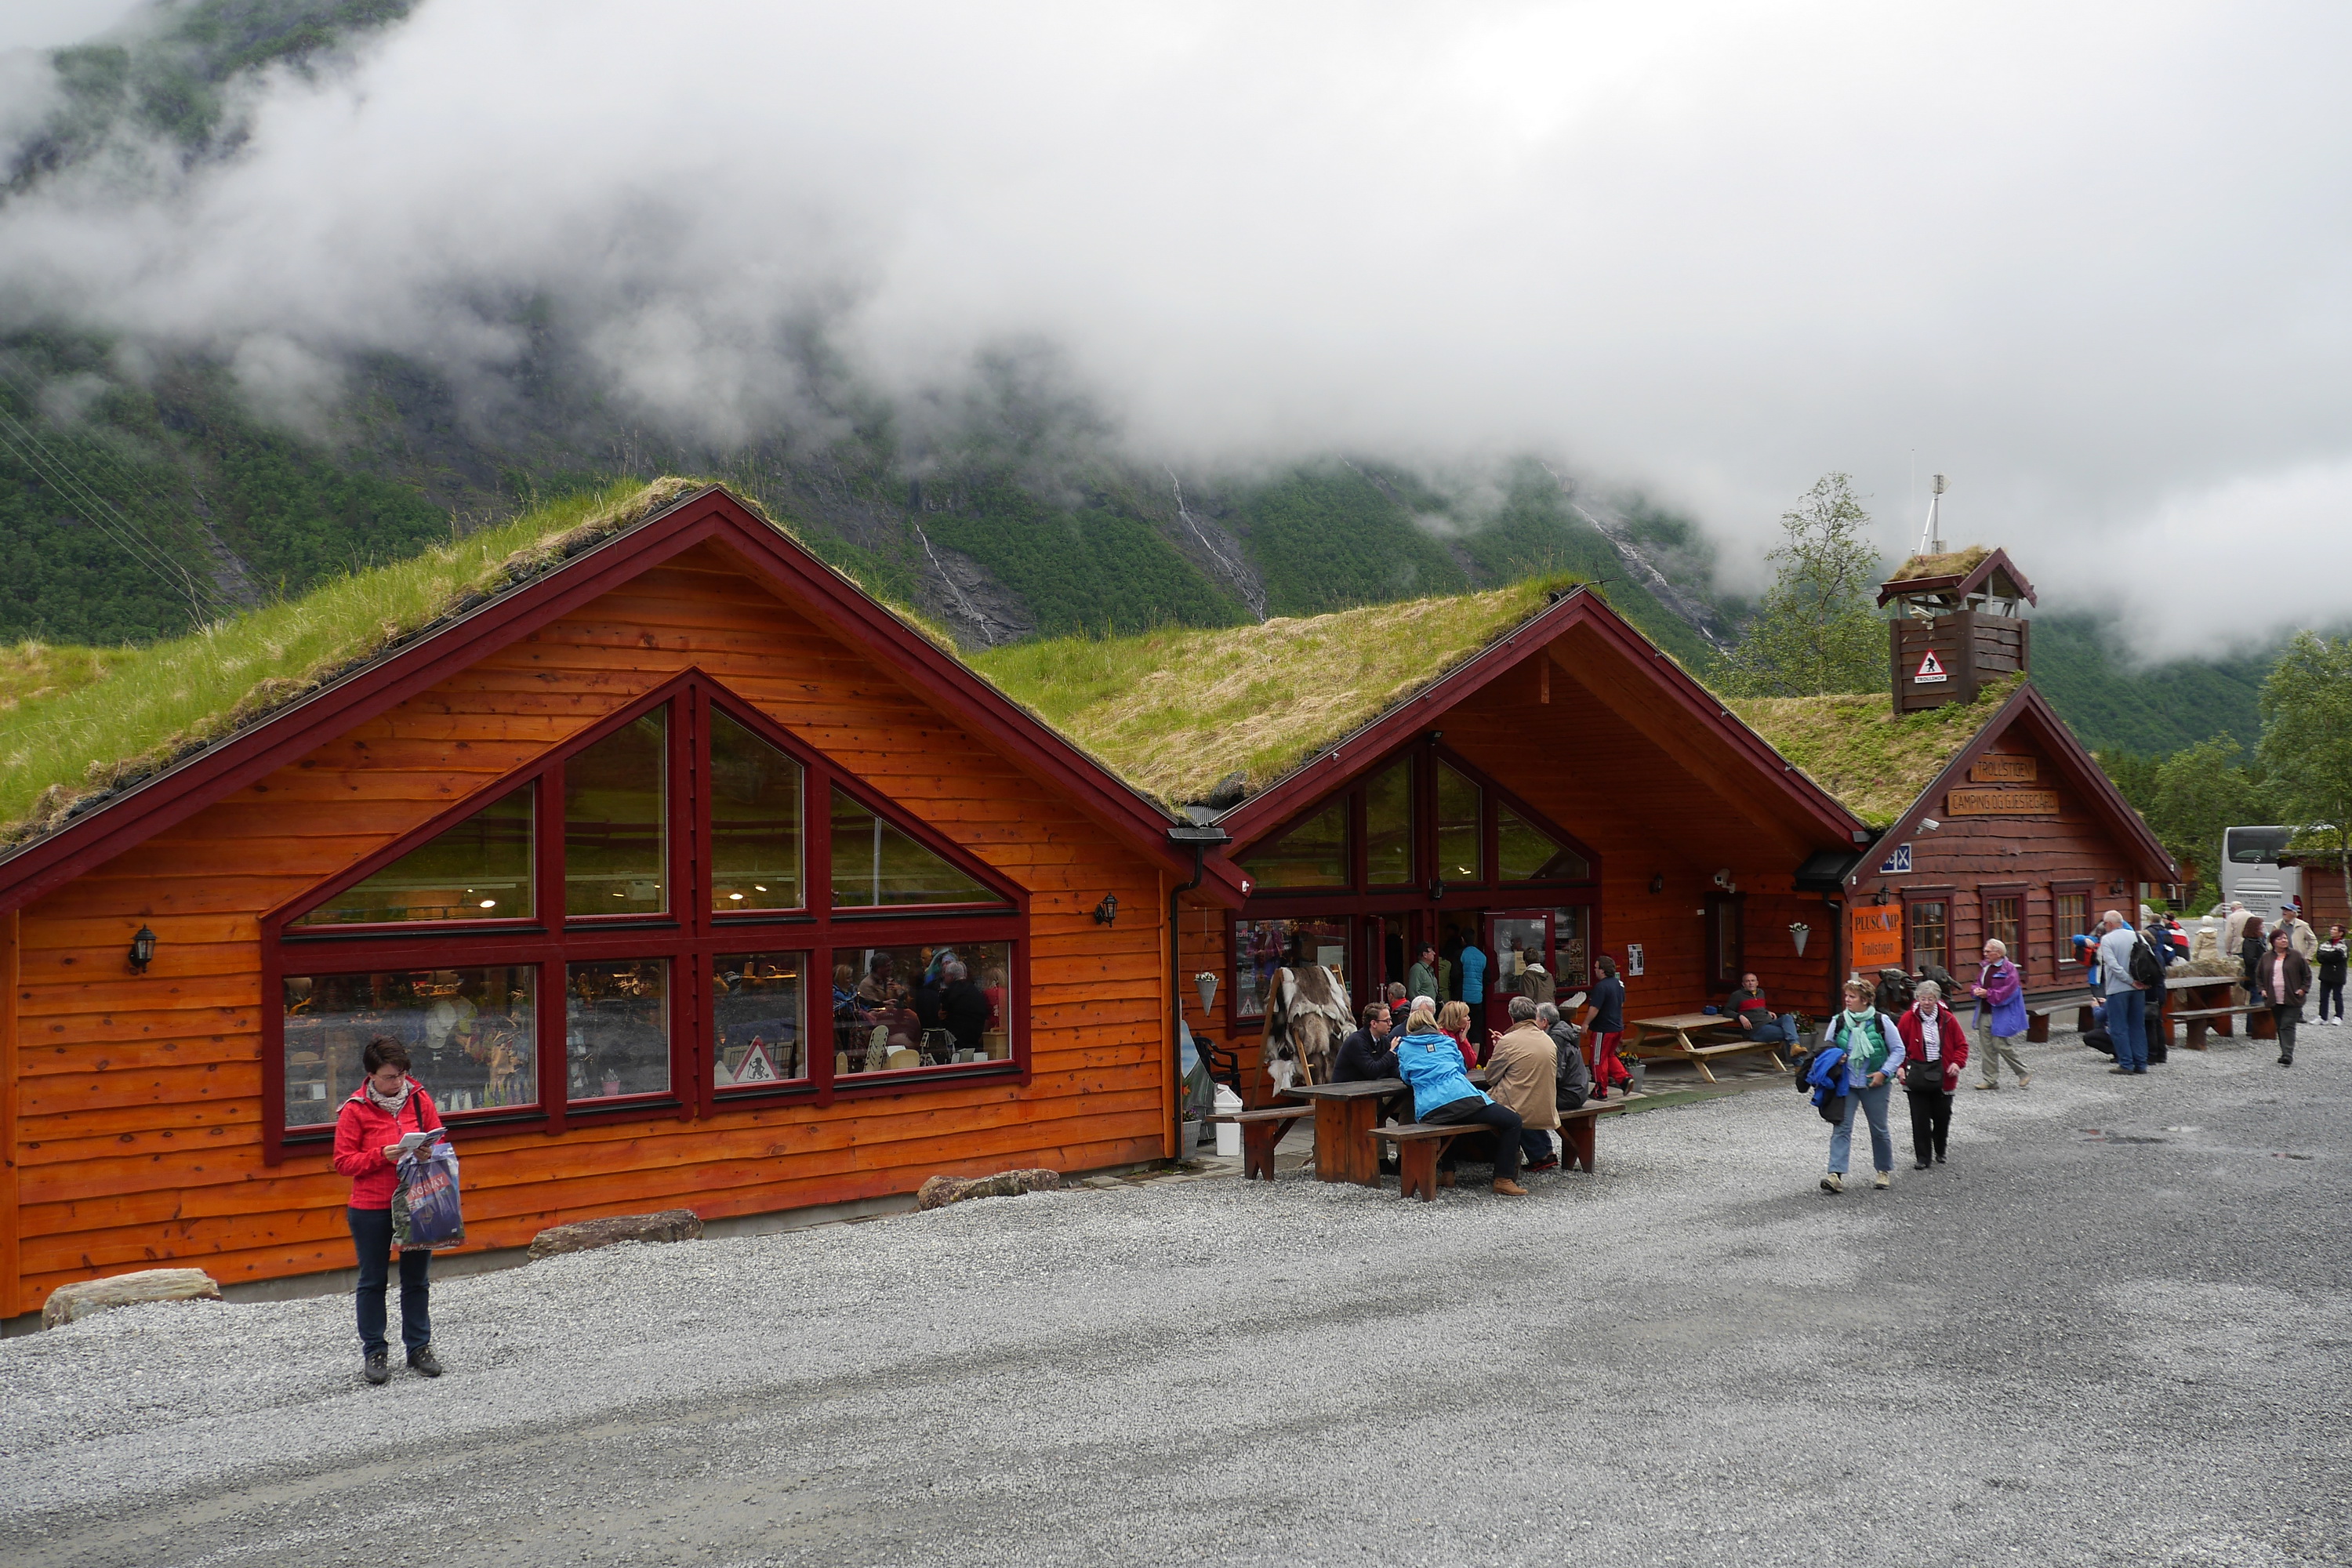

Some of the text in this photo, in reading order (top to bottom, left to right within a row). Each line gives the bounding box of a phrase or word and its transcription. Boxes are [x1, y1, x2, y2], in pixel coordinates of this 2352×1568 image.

[1977, 760, 2031, 778] TROLLSTIGEN
[1952, 792, 2056, 810] CAMPING OG GJESTEGÅRD
[1855, 911, 1900, 931] PLUSCAMP
[1861, 941, 1894, 958] Trollstigen
